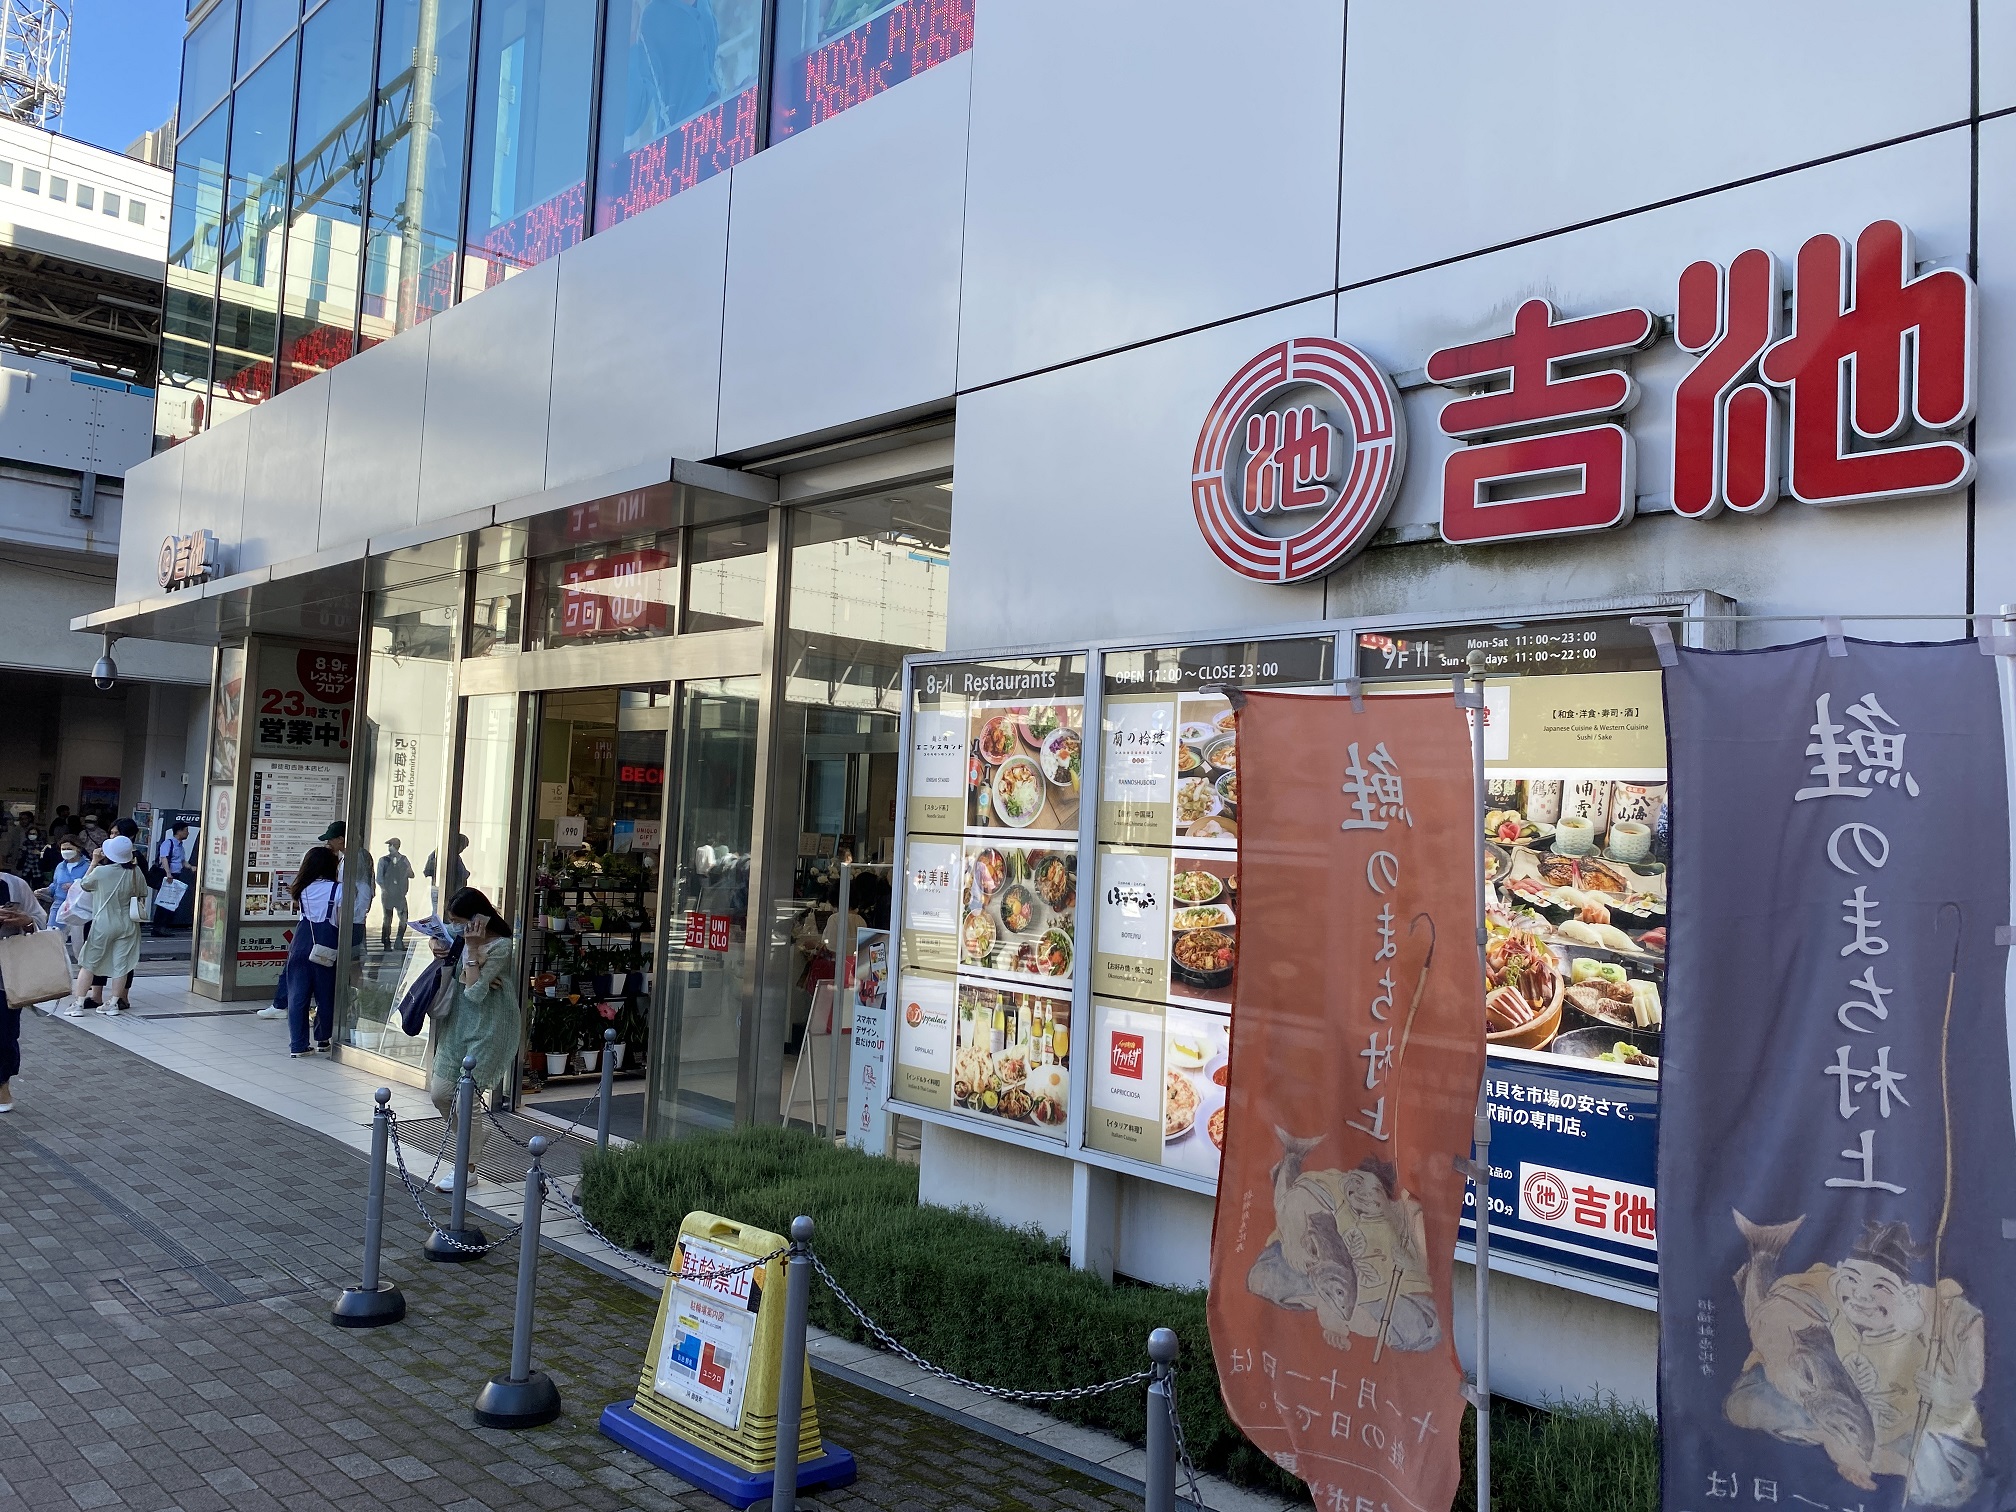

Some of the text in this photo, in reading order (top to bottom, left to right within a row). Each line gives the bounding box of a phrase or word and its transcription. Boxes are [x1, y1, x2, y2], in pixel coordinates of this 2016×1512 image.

[1423, 218, 1979, 547] 吉池
[613, 560, 642, 588] UNI
[611, 592, 643, 624] QLO
[1467, 637, 1508, 649] Mon-Sat
[1382, 644, 1409, 669] 9F
[310, 671, 353, 684] レストラン
[1116, 670, 1145, 684] OPEN
[1238, 662, 1278, 678] 23:00
[316, 682, 345, 693] フロア
[926, 671, 1056, 694] 8F Restaurants
[261, 688, 341, 720] 23時まで
[175, 814, 200, 822] acure
[712, 919, 727, 933] UNI
[711, 934, 727, 948] QLO
[857, 1015, 877, 1025] スマホで
[1110, 1087, 1141, 1099] CAPRICCIOSA
[1572, 1185, 1656, 1240] 吉池
[681, 1250, 749, 1300] 駐輪禁止
[702, 1370, 721, 1382] ユニクロ
